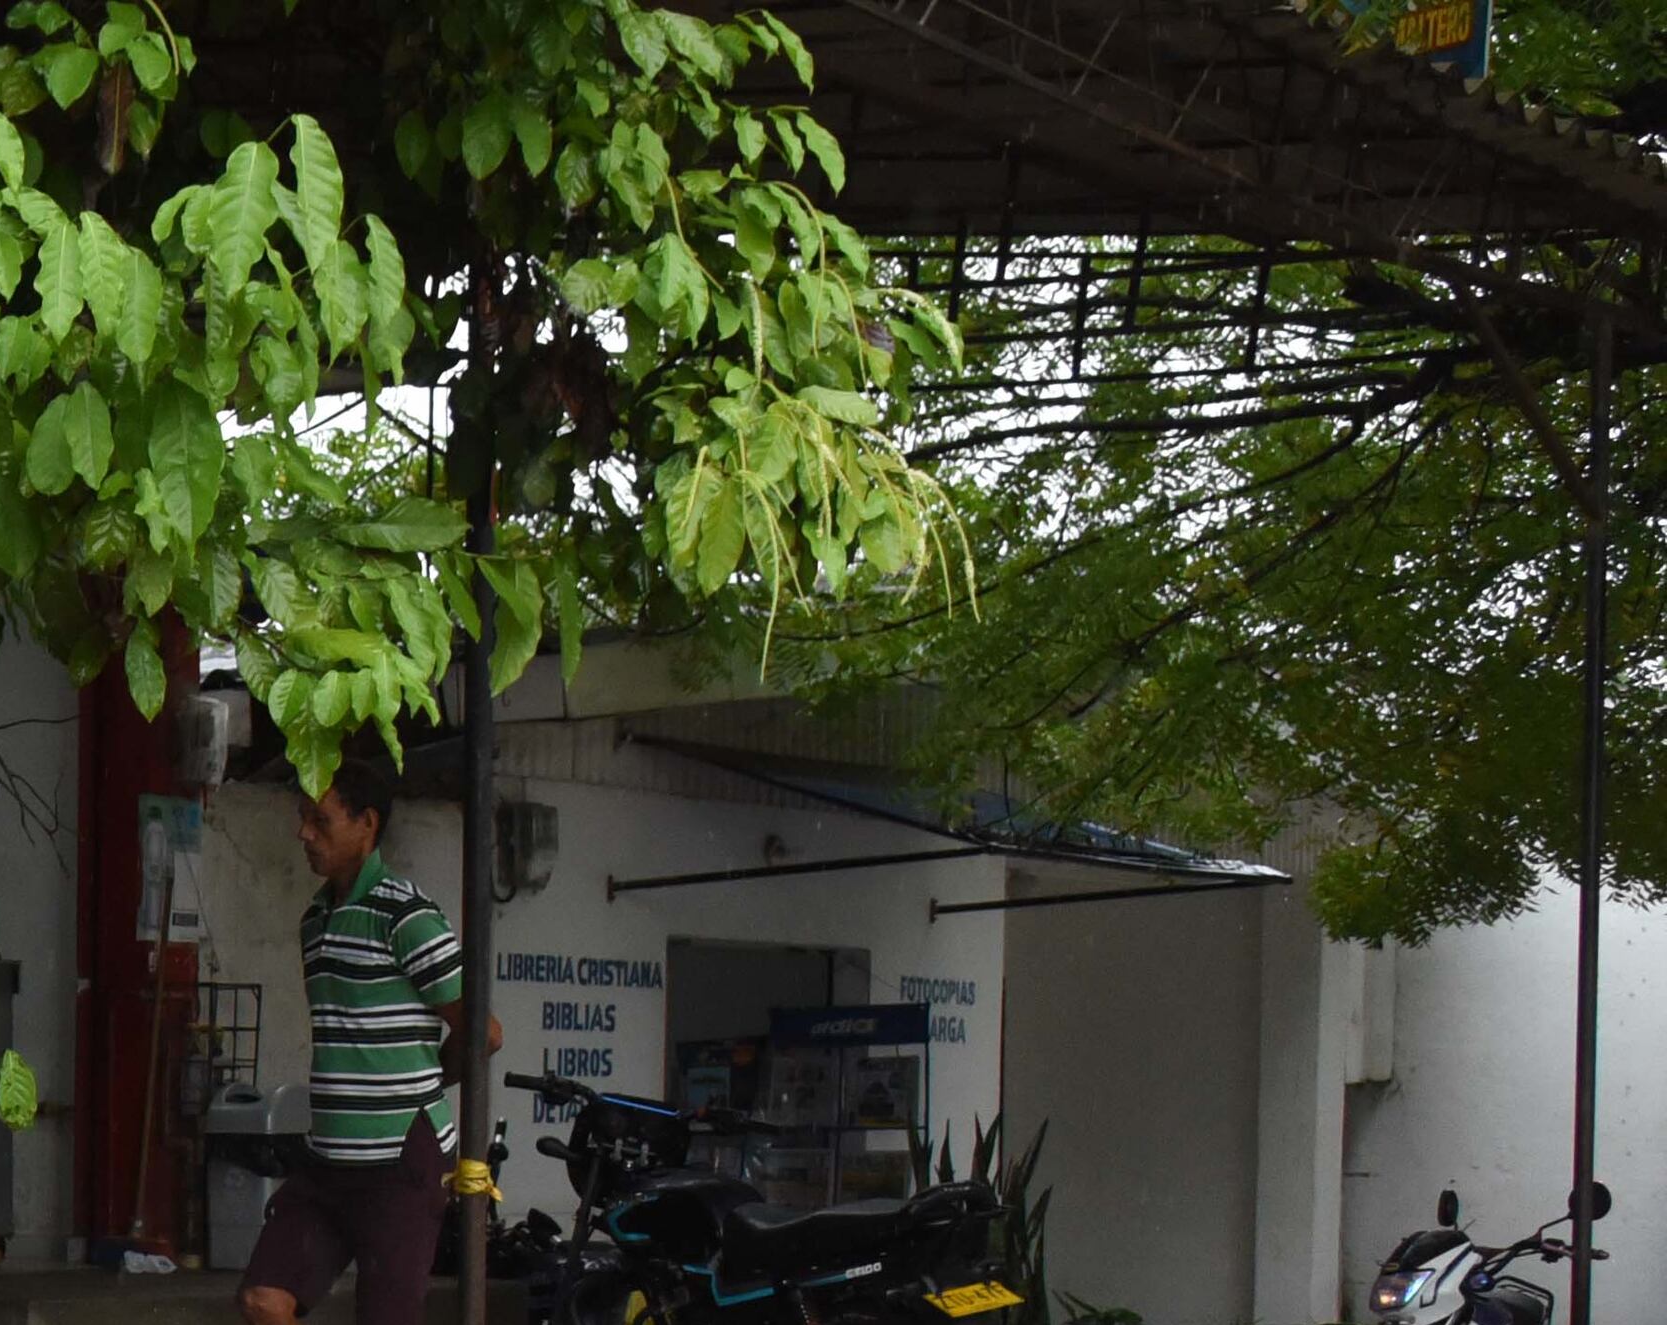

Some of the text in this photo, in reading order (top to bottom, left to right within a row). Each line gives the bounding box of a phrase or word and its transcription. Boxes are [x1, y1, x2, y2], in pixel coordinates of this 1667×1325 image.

[497, 952, 664, 989] LIBRERIA CRISTIANA
[900, 976, 976, 1006] FOTOCOPIAS
[542, 1001, 616, 1032] BIBLIAS
[930, 1015, 966, 1044] ARGA
[543, 1047, 613, 1077] LIBROS
